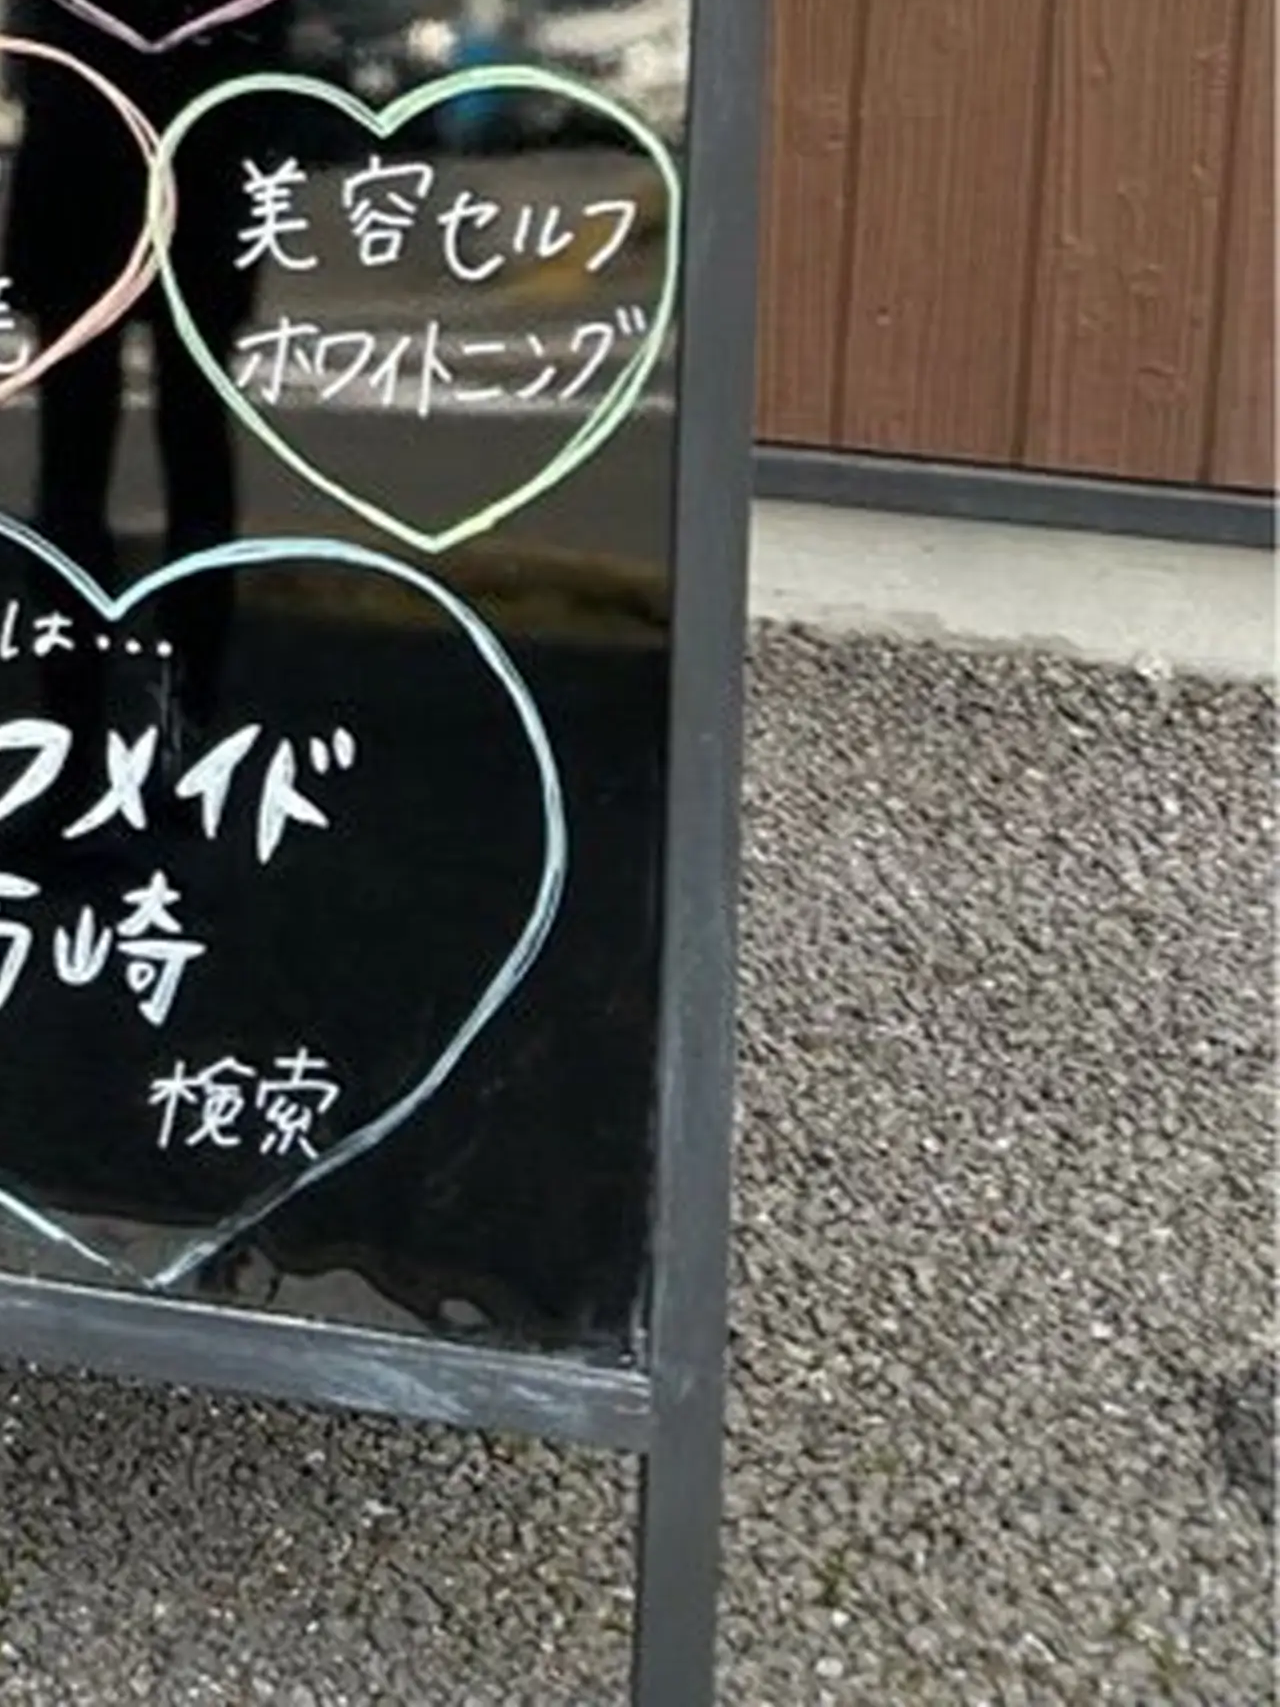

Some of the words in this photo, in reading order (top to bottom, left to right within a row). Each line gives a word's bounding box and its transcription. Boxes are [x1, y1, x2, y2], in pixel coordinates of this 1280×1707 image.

[233, 153, 638, 282] 美容セルフ
[236, 305, 648, 419] ホワイトニング
[146, 1045, 341, 1161] 検索
